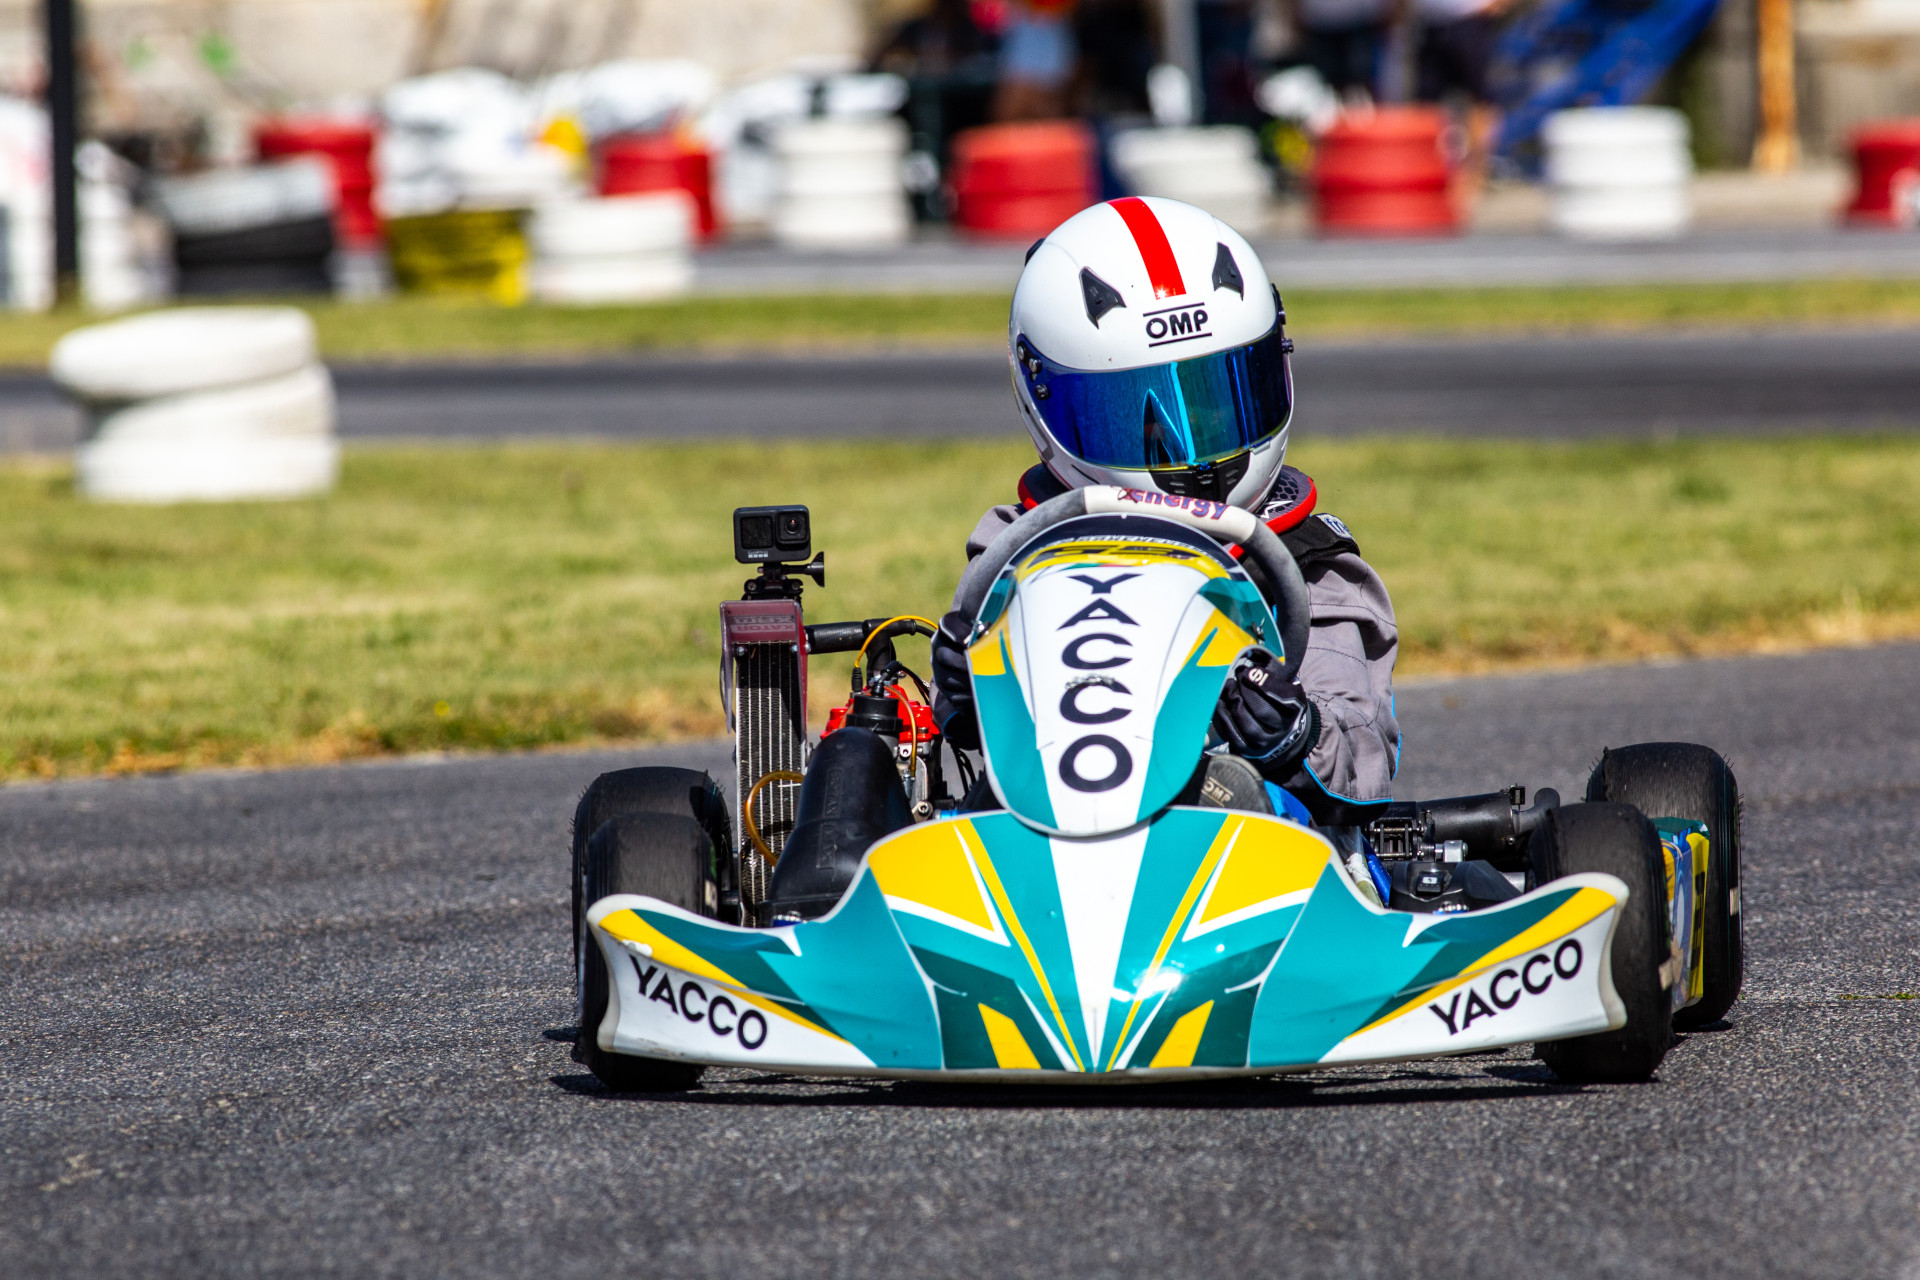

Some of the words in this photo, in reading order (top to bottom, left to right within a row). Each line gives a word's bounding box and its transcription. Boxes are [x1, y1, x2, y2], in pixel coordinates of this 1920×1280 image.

[1146, 309, 1208, 339] OMP
[1056, 573, 1144, 793] YACCO
[628, 954, 767, 1050] YACCO
[1428, 938, 1583, 1035] YACCO
